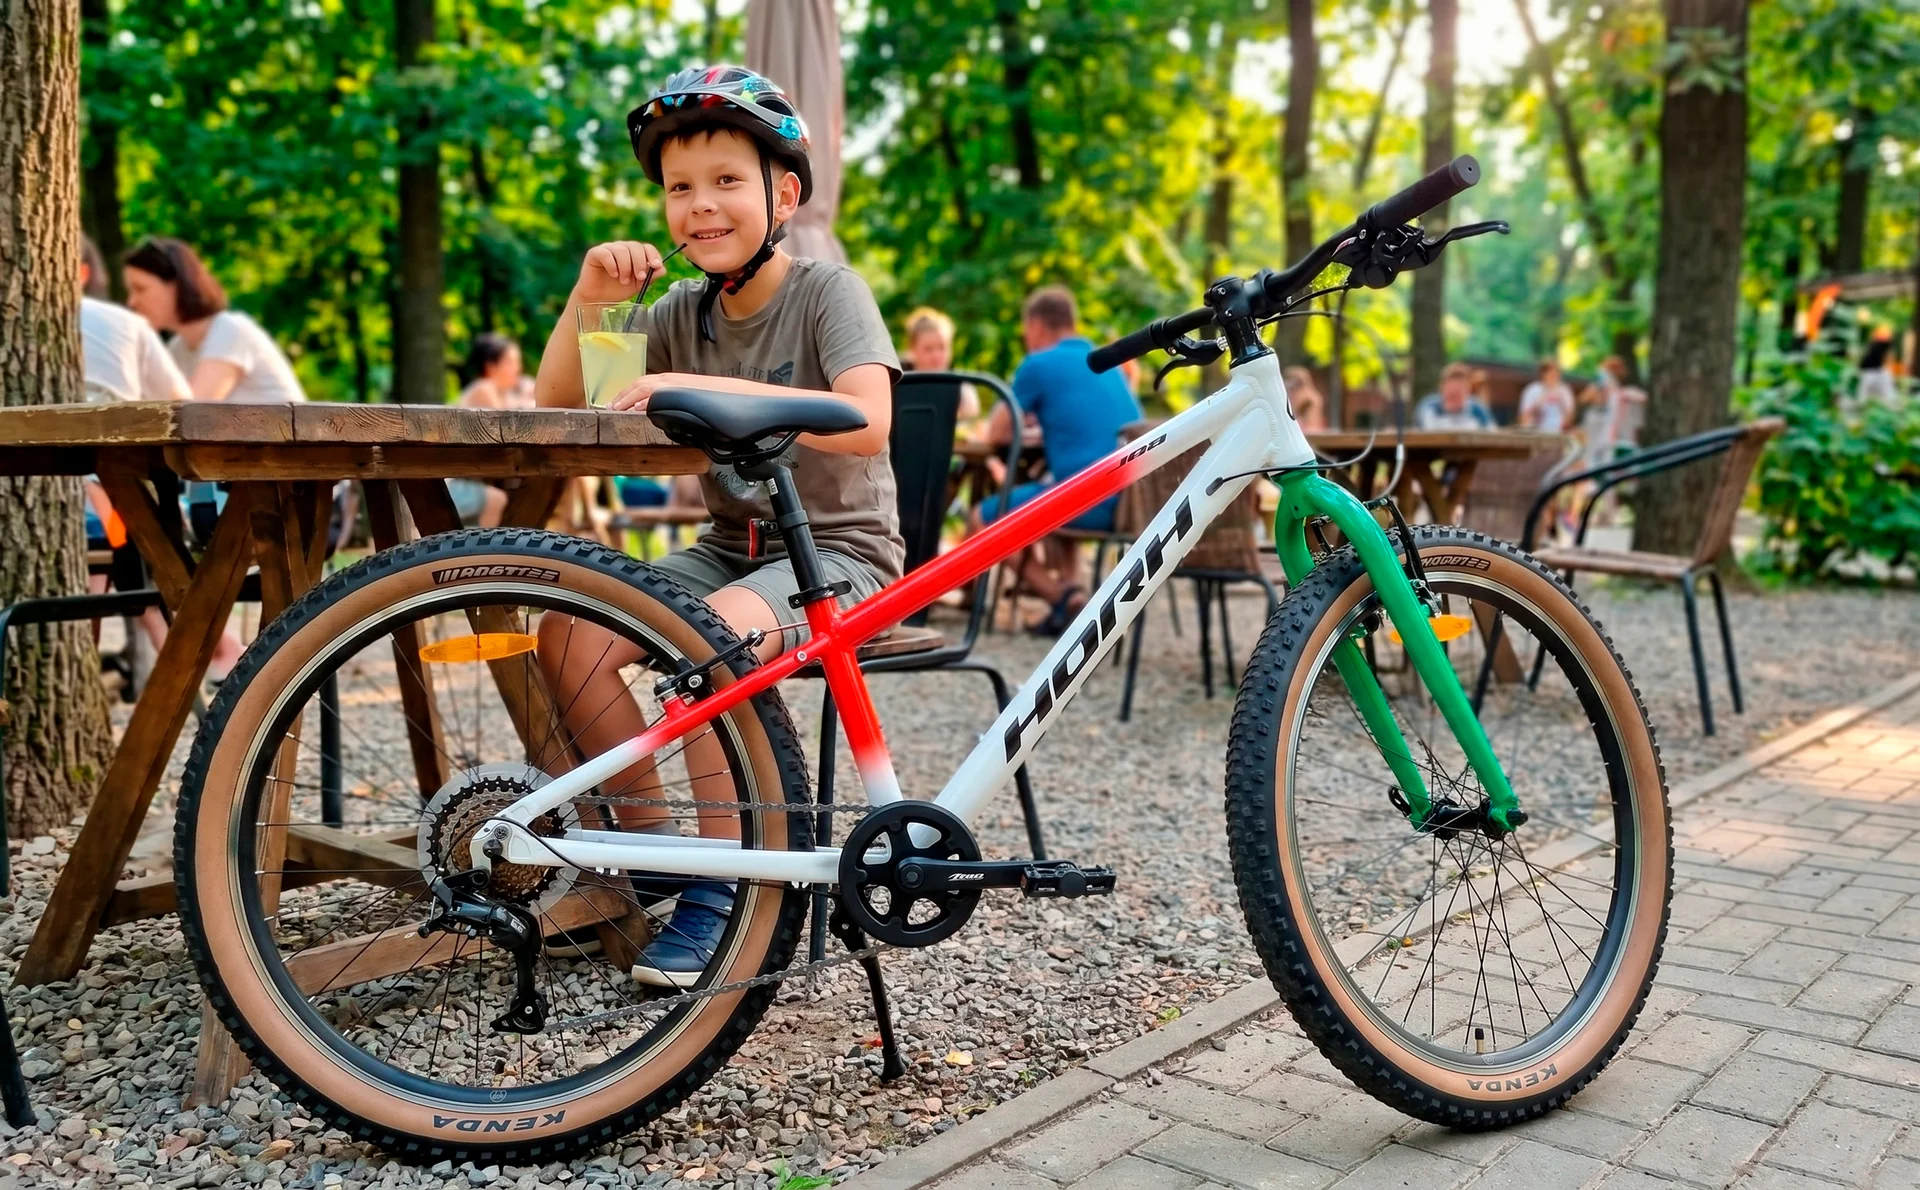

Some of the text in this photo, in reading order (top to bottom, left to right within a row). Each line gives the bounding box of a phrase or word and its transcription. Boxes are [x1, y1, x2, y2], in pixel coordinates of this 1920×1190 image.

[1004, 495, 1194, 764] HORH
[1466, 1063, 1558, 1092] KENDA
[433, 1110, 566, 1133] KENDA
